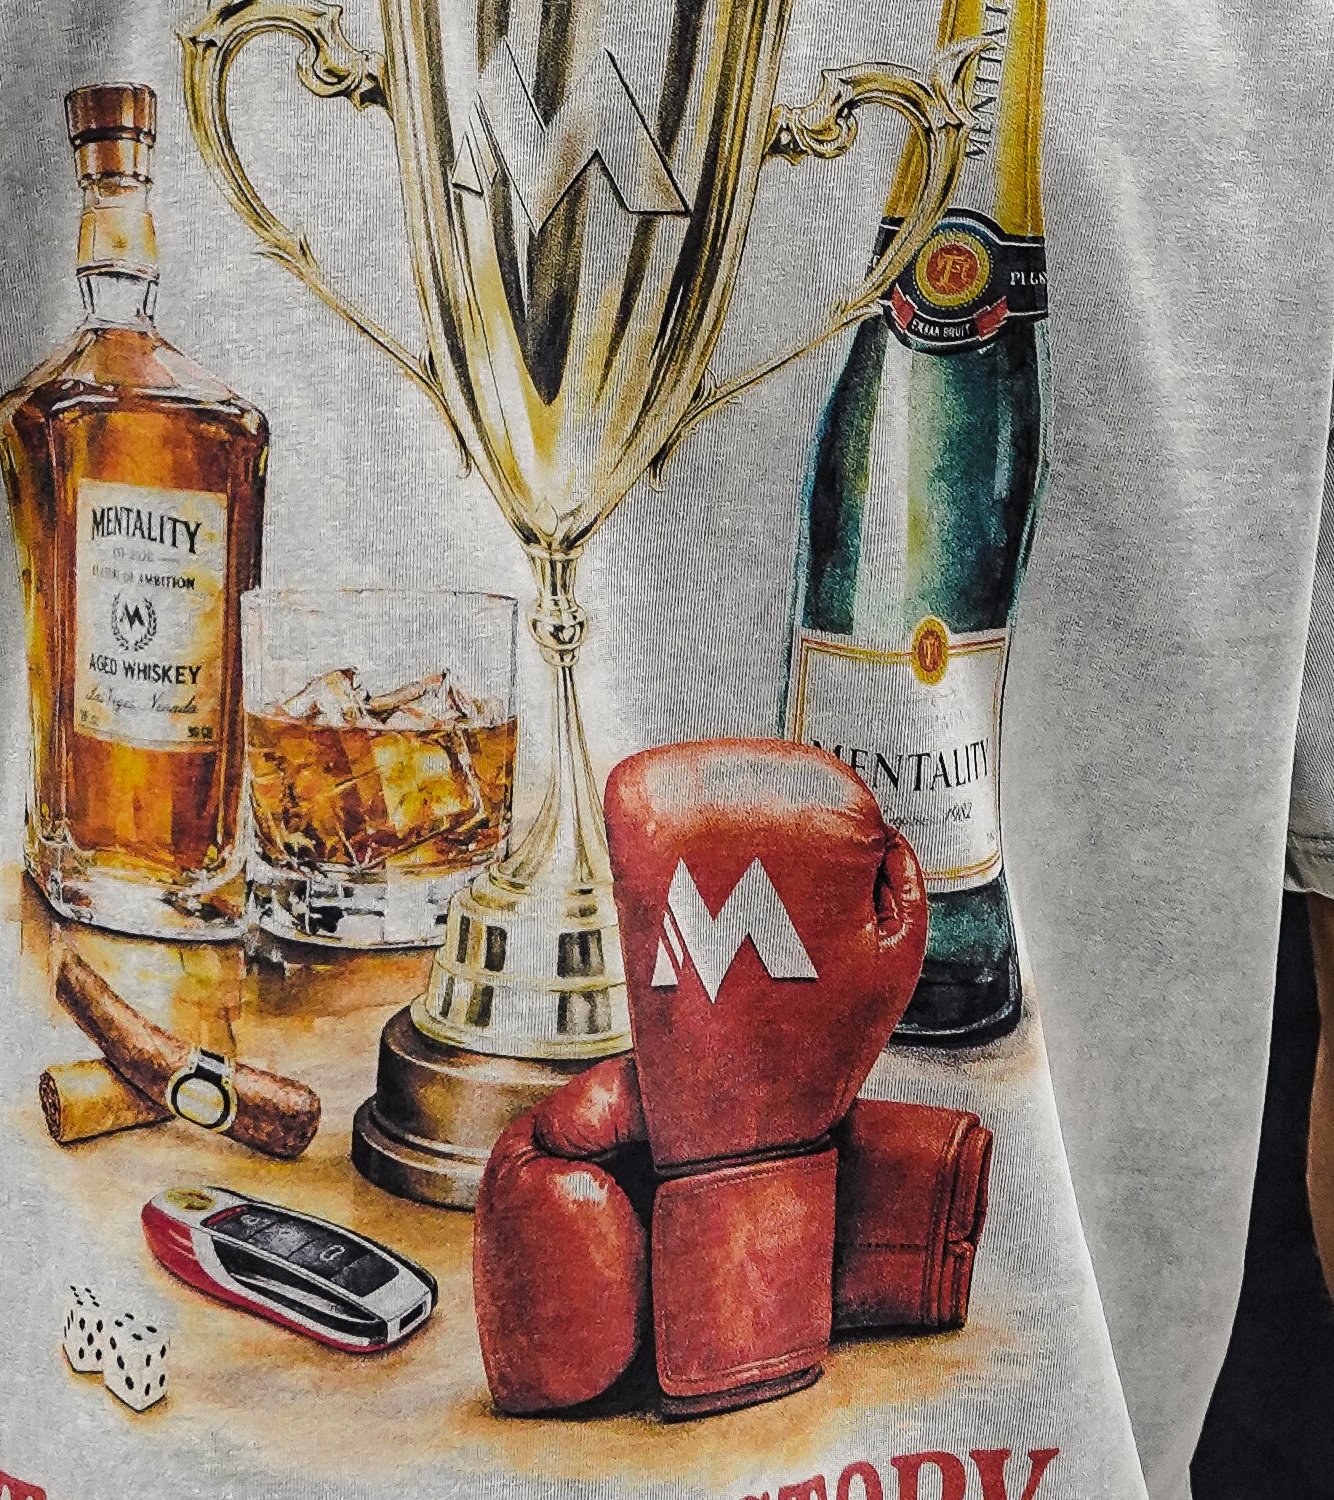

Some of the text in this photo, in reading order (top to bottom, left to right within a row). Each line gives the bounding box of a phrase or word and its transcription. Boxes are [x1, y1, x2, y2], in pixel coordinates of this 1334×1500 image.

[90, 505, 203, 555] MENTALITY
[89, 653, 203, 685] AGED WHISKEY
